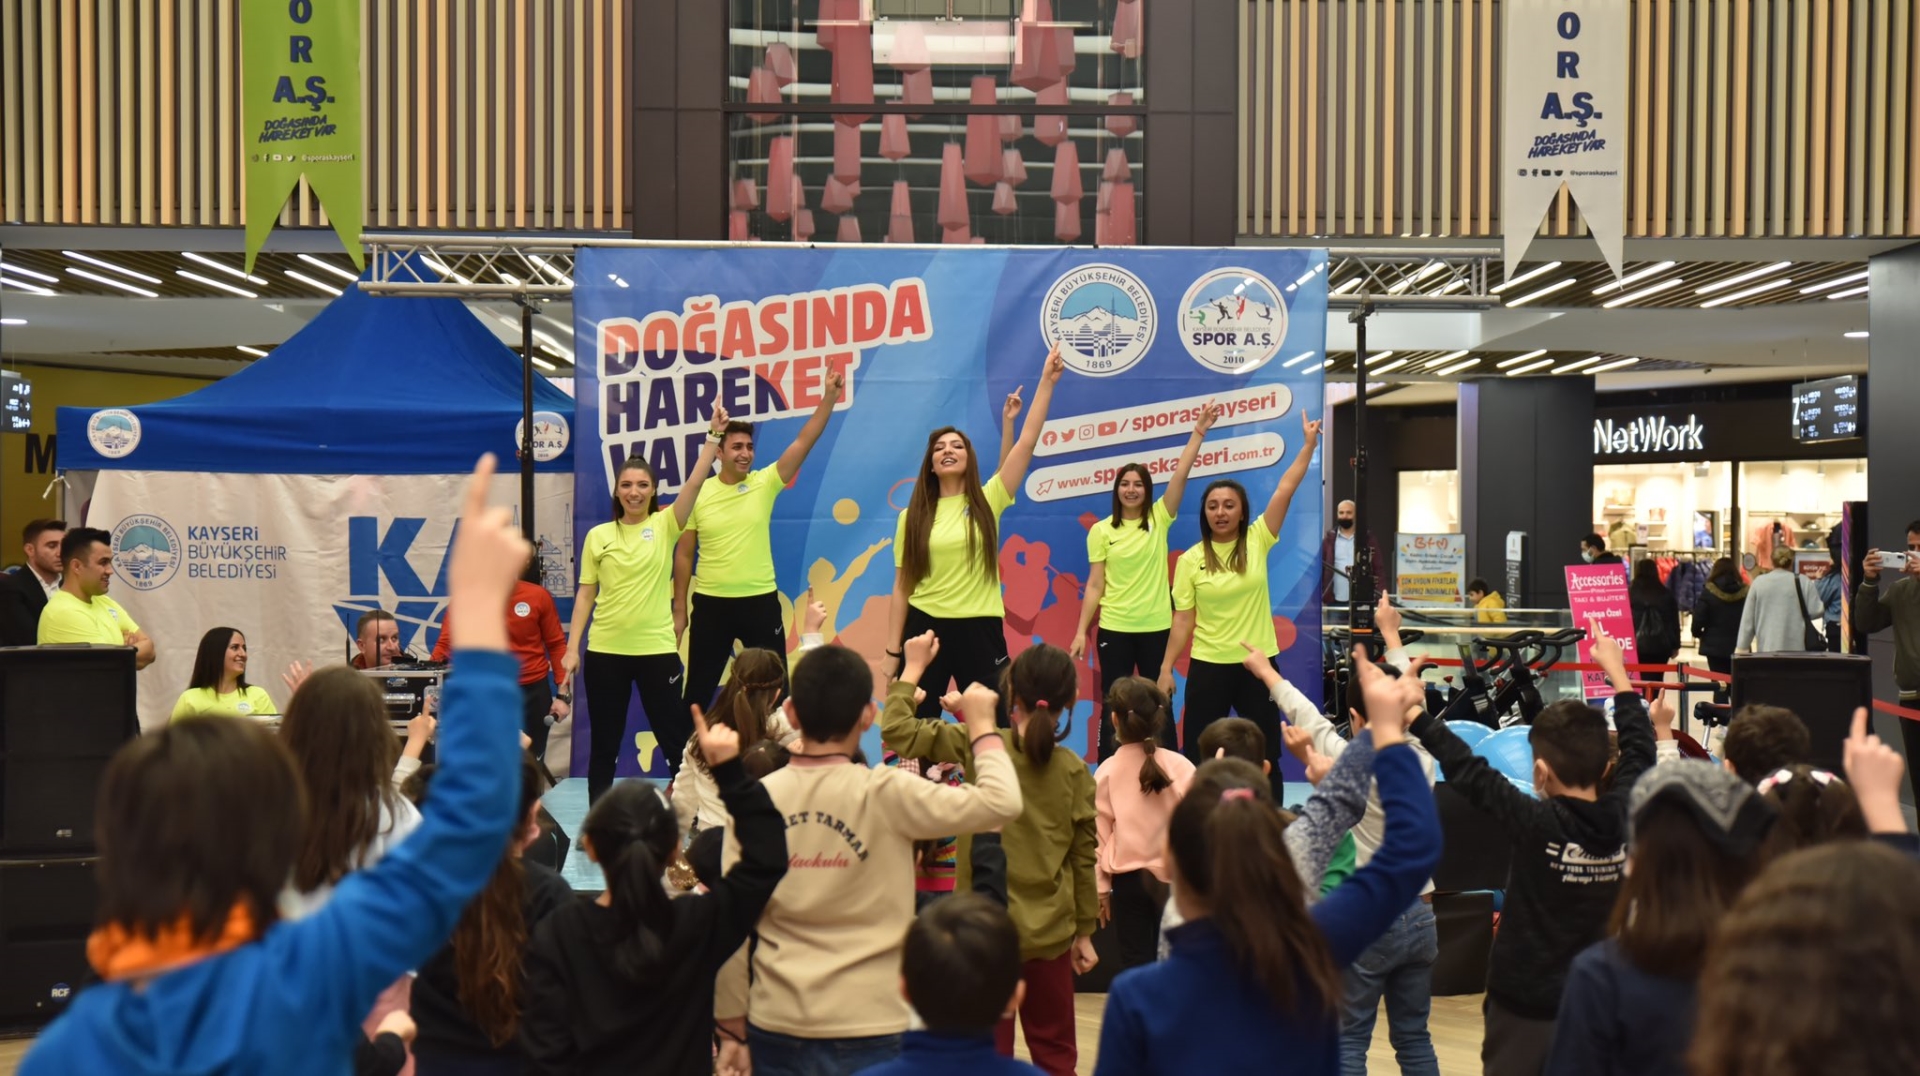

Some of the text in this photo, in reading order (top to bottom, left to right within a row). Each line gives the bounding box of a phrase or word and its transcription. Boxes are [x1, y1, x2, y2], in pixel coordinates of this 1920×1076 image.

[272, 76, 336, 112] A.Ş.
[1540, 92, 1603, 128] A.Ş.
[264, 114, 328, 131] DOĞASINDA
[258, 124, 337, 144] HAREKET VAR
[1534, 129, 1597, 147] DOĞASINDA
[1527, 139, 1606, 159] HAREKET VAR
[1060, 271, 1127, 296] BÜYÜKŞEHİR
[1127, 284, 1150, 343] BELEDİYESİ
[604, 283, 926, 377] DOĞASINDA
[1192, 332, 1275, 349] SPOR A.Ş.
[1086, 360, 1112, 369] 1869
[1223, 356, 1245, 364] 2010
[605, 351, 854, 435] HAREKET
[1593, 413, 1704, 454] NetWork
[1570, 570, 1624, 590] Accessories
[784, 811, 869, 862] ET TARMAN
[51, 987, 70, 998] RCF
